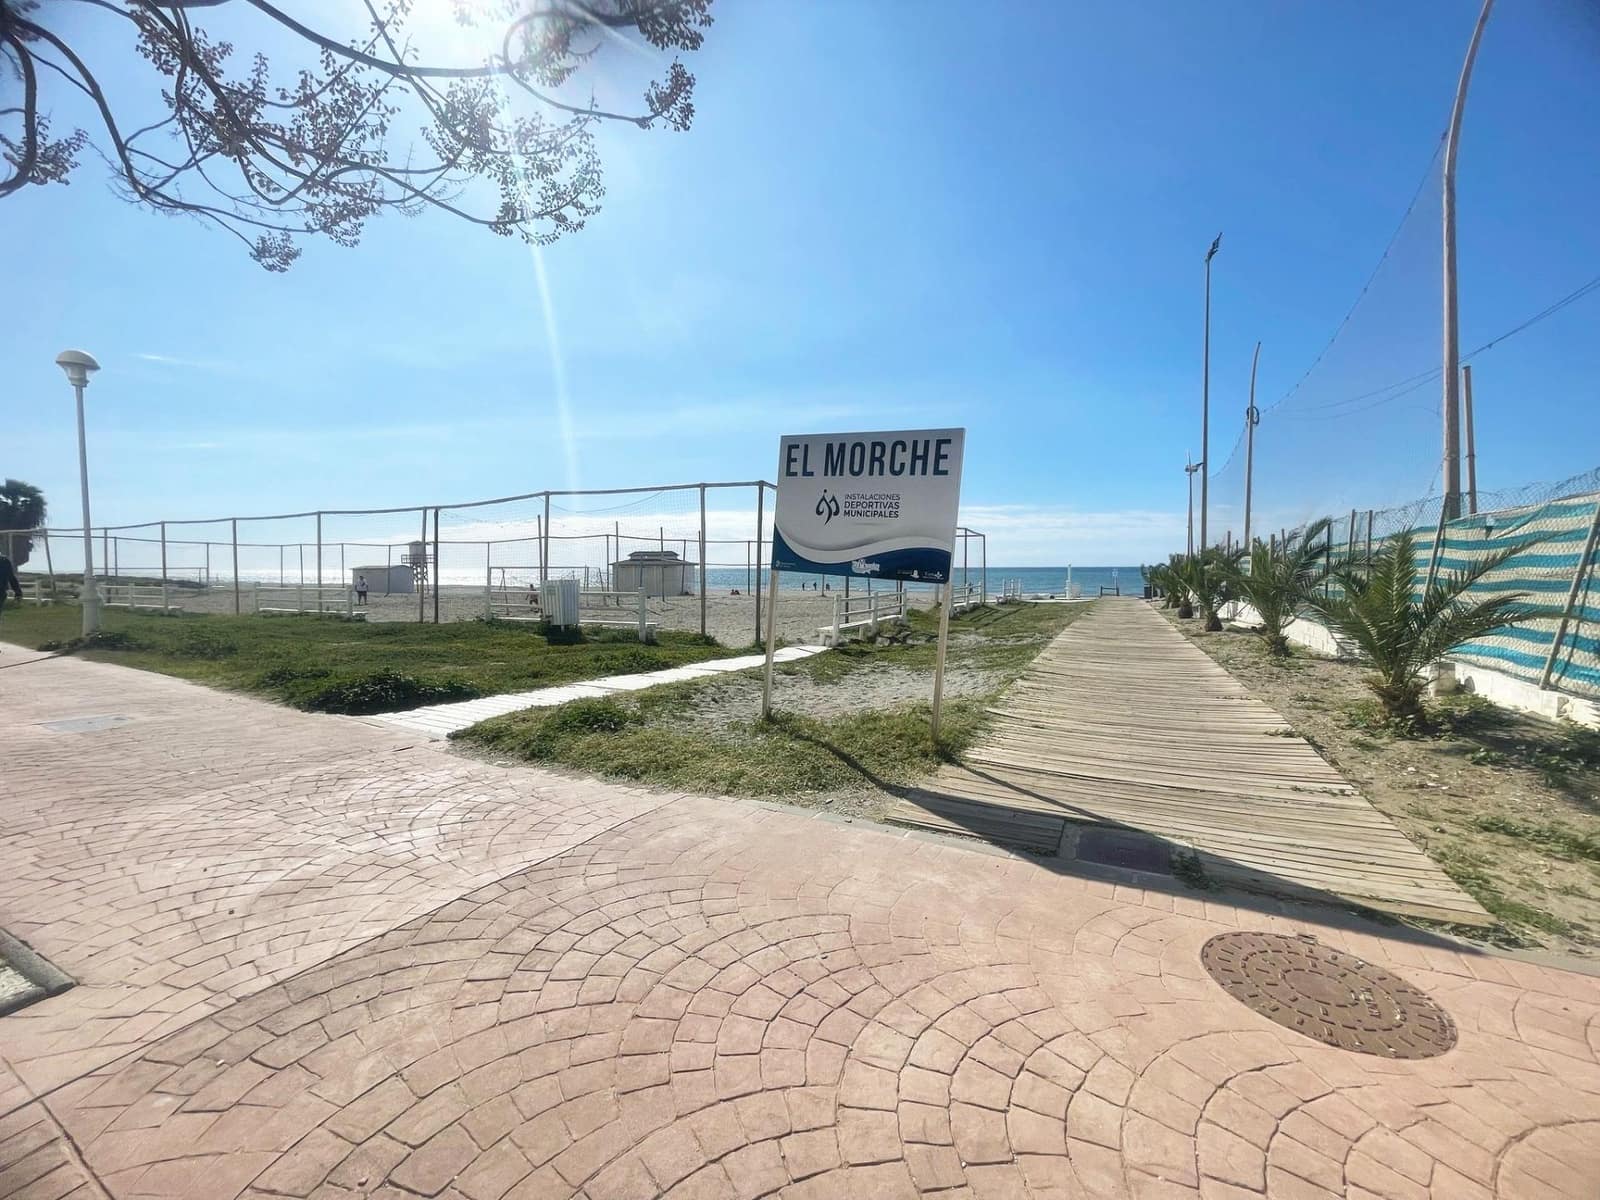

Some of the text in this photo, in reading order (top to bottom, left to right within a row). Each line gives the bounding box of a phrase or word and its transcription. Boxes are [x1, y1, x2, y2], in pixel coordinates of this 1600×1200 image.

[785, 438, 952, 477] EL MORCHE
[845, 493, 901, 501] INSTALACIONES
[844, 501, 900, 509] DEPORTIVAS
[843, 509, 899, 518] MUNICIPALES
